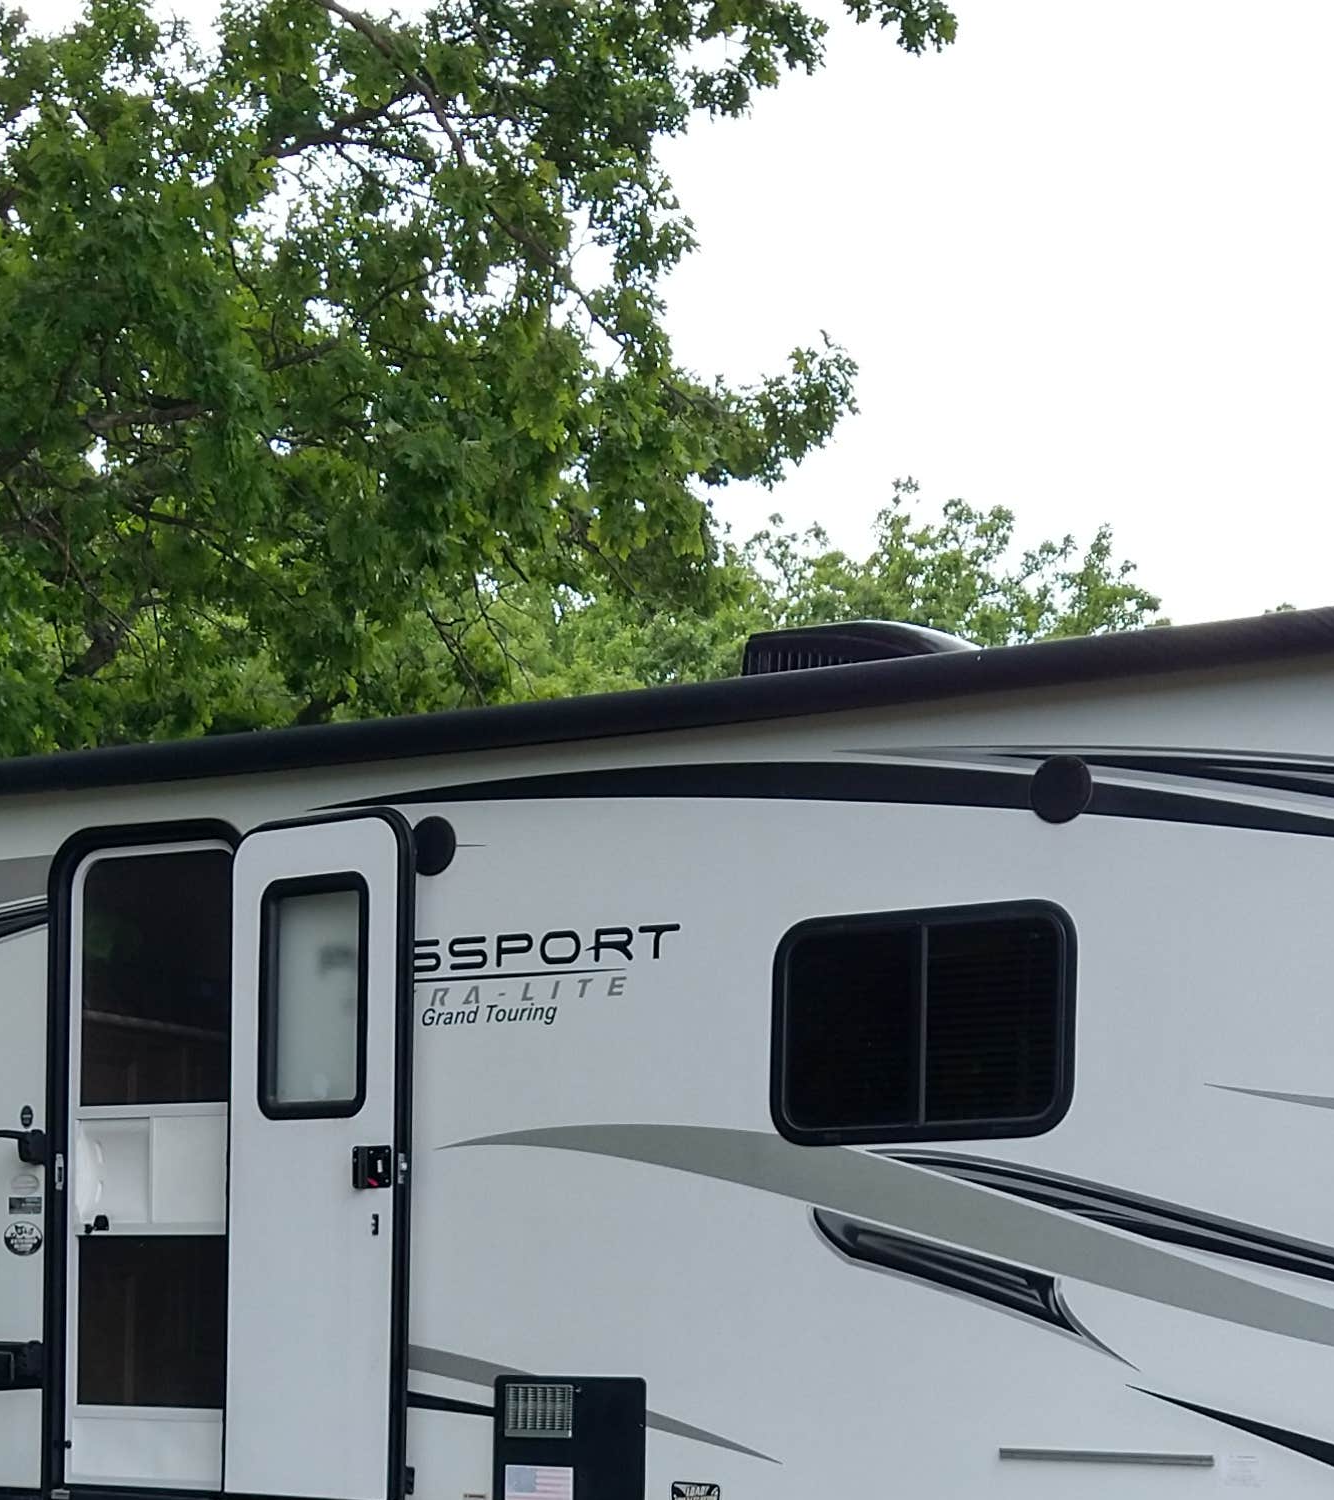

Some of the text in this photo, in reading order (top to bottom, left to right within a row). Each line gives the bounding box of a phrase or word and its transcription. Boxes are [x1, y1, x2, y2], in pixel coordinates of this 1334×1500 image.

[415, 976, 627, 1007] RA-LITE
[421, 1003, 558, 1026] Grand Touring
